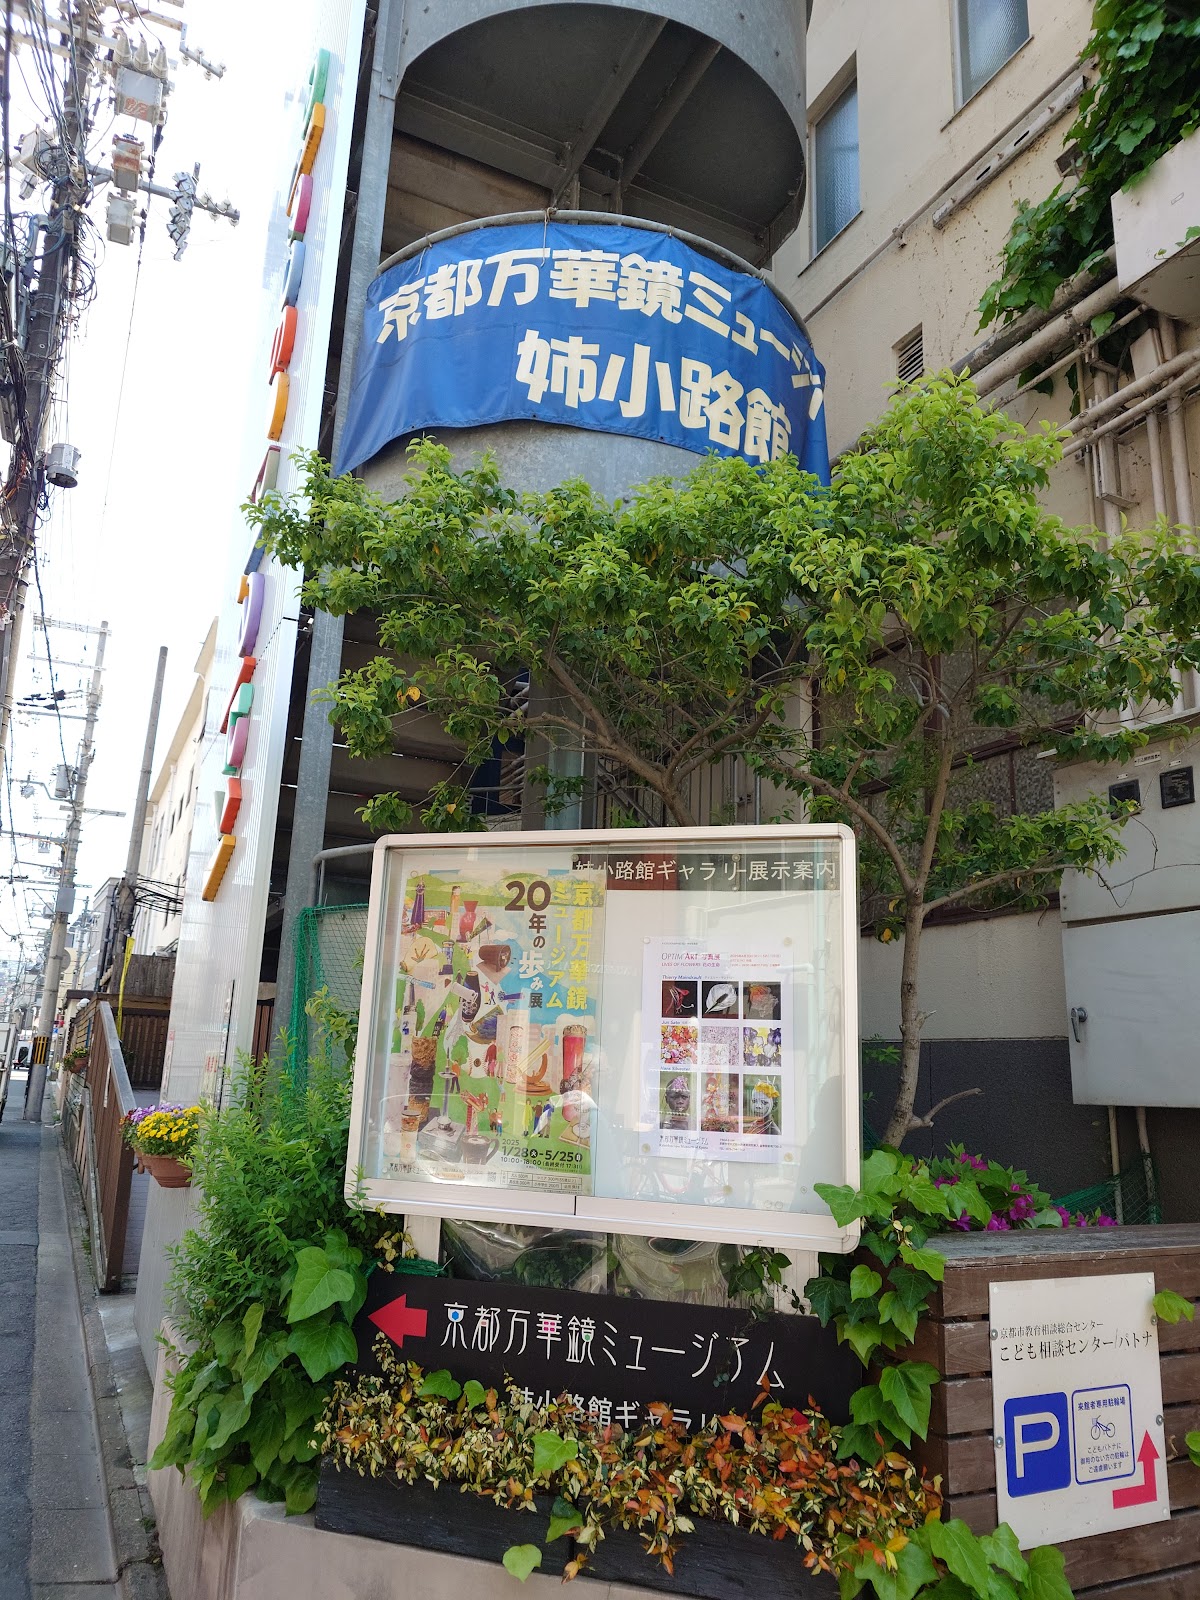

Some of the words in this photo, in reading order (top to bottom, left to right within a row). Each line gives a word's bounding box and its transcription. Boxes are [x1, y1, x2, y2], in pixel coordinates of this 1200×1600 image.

[515, 329, 792, 463] 姉小路館
[546, 881, 570, 1009] ミュージアム
[565, 882, 594, 1010] 京都万華鏡
[502, 1138, 520, 1146] 2025
[440, 1301, 785, 1389] 京都万華鏡ミュージアム
[1000, 1319, 1104, 1340] 京都市教育相談総合センター
[1013, 1411, 1061, 1479] P
